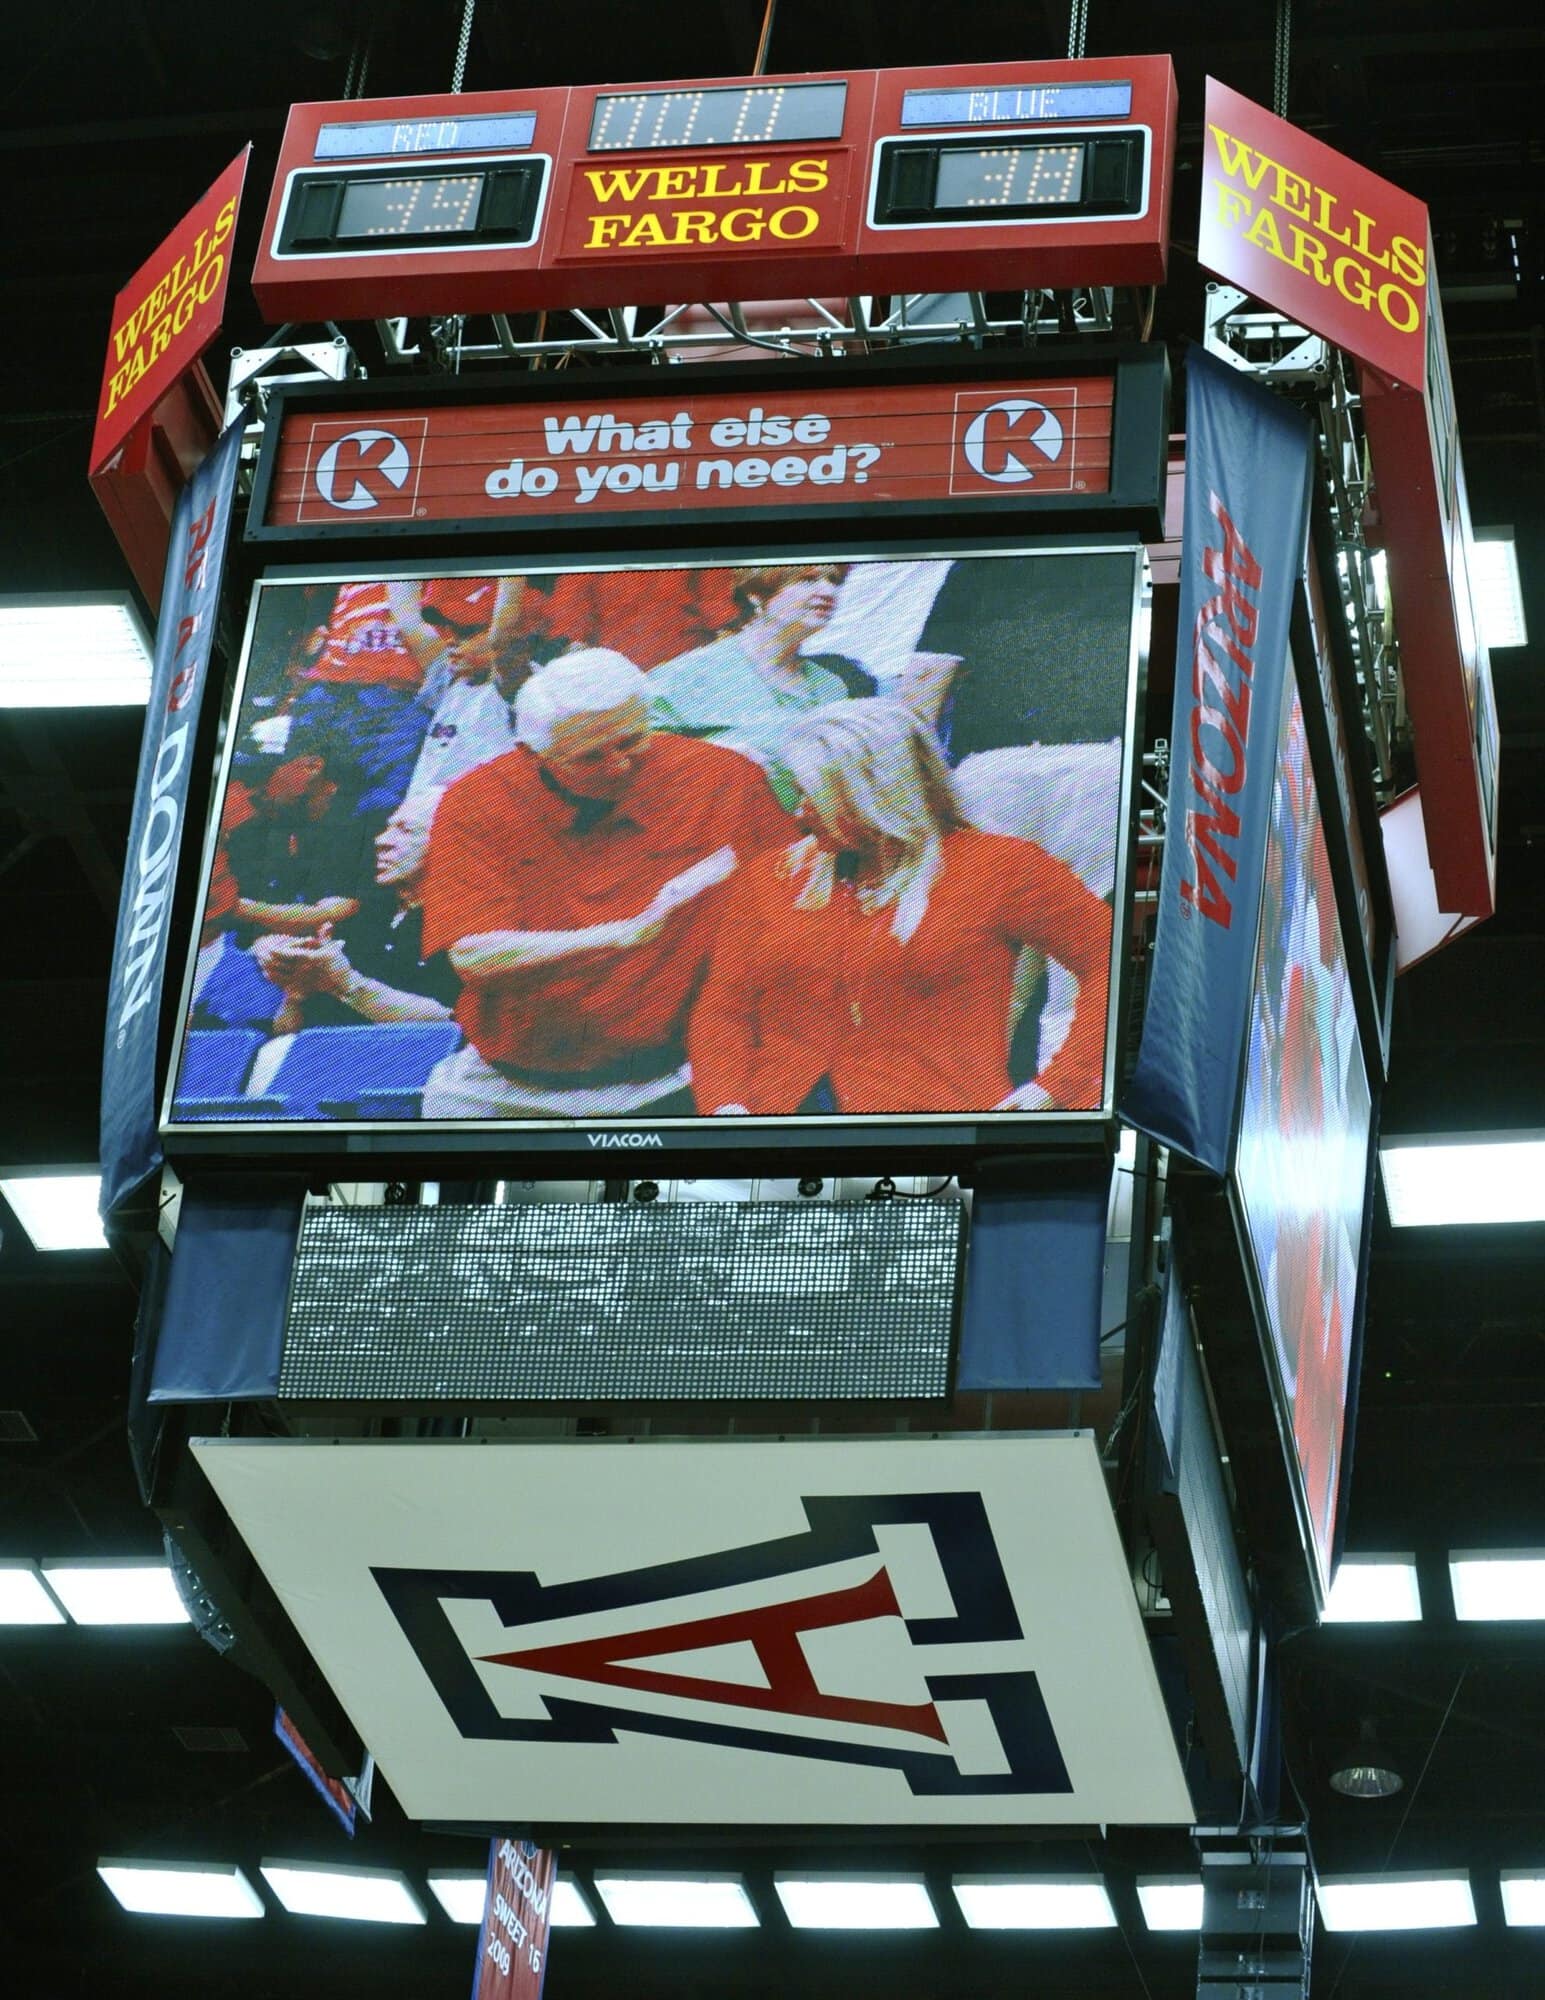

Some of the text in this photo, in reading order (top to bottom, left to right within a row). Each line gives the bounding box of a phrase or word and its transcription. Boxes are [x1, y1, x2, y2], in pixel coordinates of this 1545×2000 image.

[968, 88, 1061, 122] BLUE
[391, 121, 459, 153] RED
[367, 176, 480, 236] 39
[583, 159, 830, 203] WELLS
[966, 146, 1079, 206] 38
[1208, 122, 1428, 288] WELLS
[583, 205, 821, 249] FARGO
[1212, 178, 1421, 335] FARGO
[112, 196, 237, 364] WELLS
[103, 253, 226, 421] FARGO
[543, 408, 831, 456] What else
[484, 442, 882, 505] do you need?
[1180, 488, 1264, 931] ARIZONA
[117, 720, 190, 1030] DOWN
[587, 1133, 663, 1148] VIACOM
[498, 1838, 549, 1924] ARIZONA
[493, 1893, 542, 1974] SWEET 16
